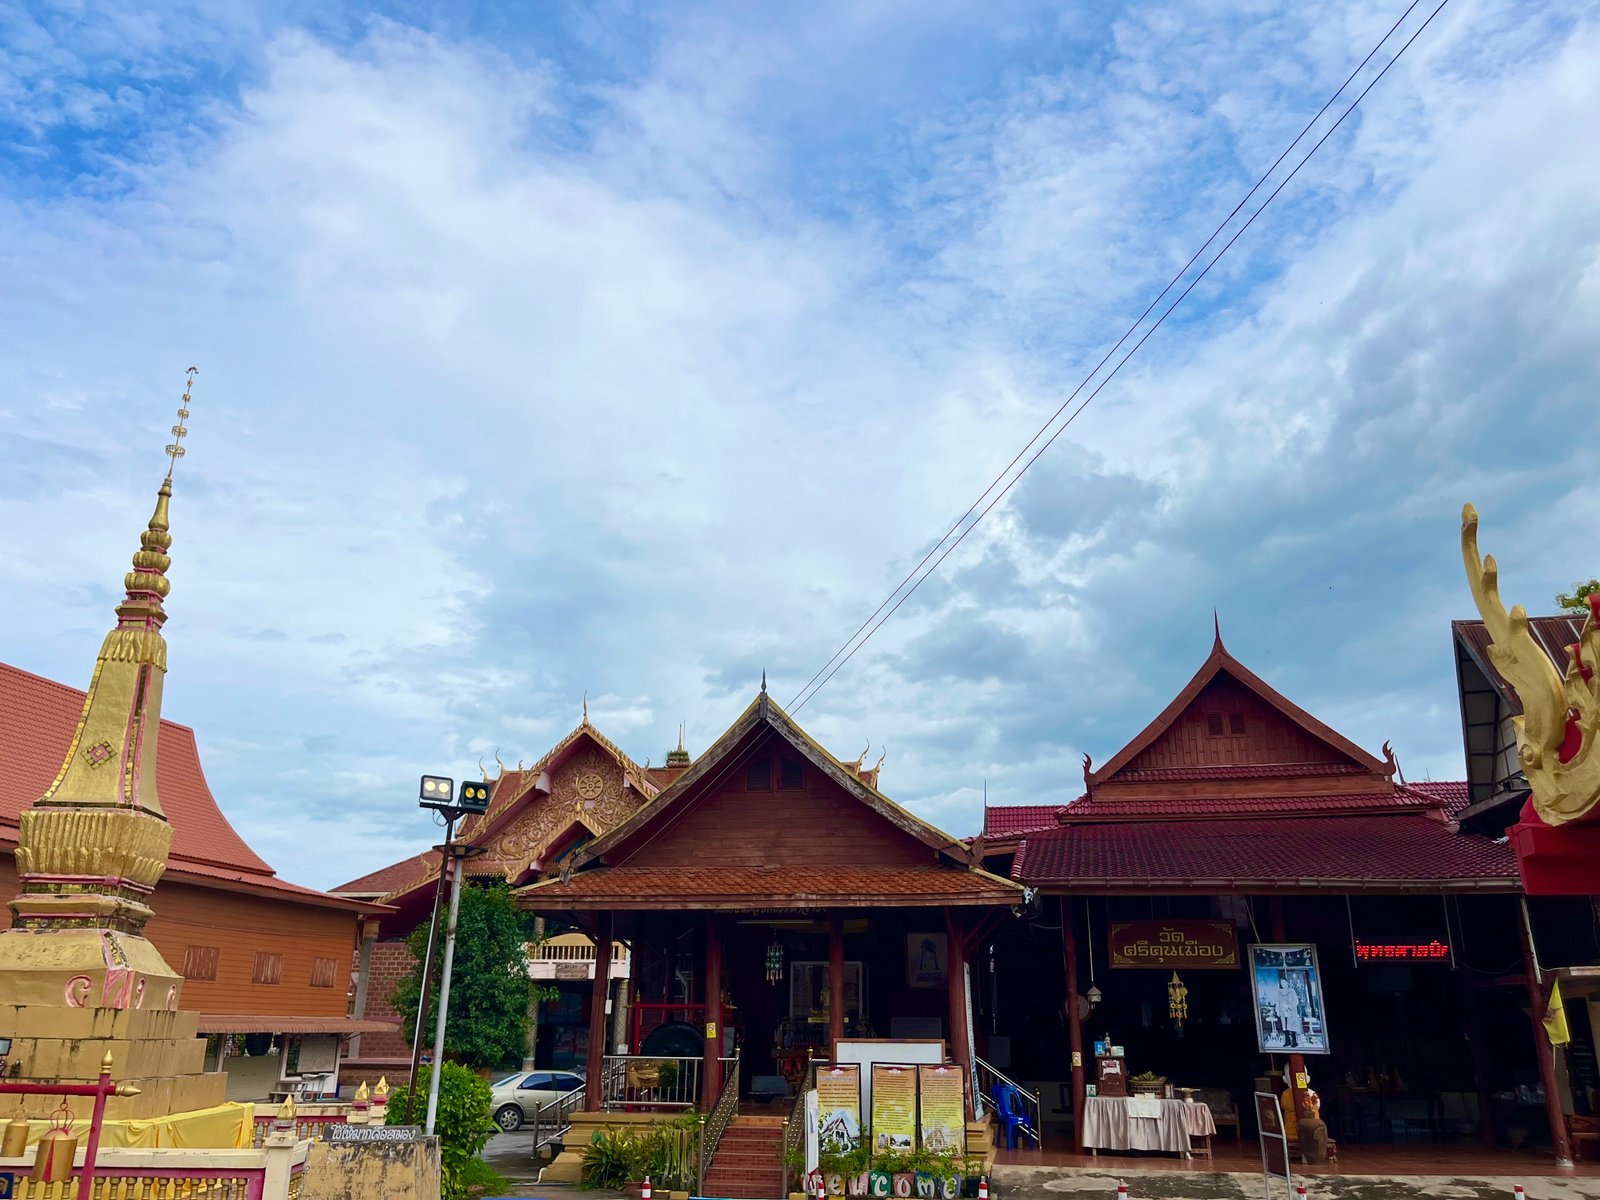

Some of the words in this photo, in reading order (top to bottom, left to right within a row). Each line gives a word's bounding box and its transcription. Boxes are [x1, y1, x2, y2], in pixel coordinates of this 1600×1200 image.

[1159, 927, 1185, 942] วัด
[1123, 940, 1224, 963] ศรีคุนเมือง
[331, 1125, 416, 1140] ใช้ให้มากคือสมอง
